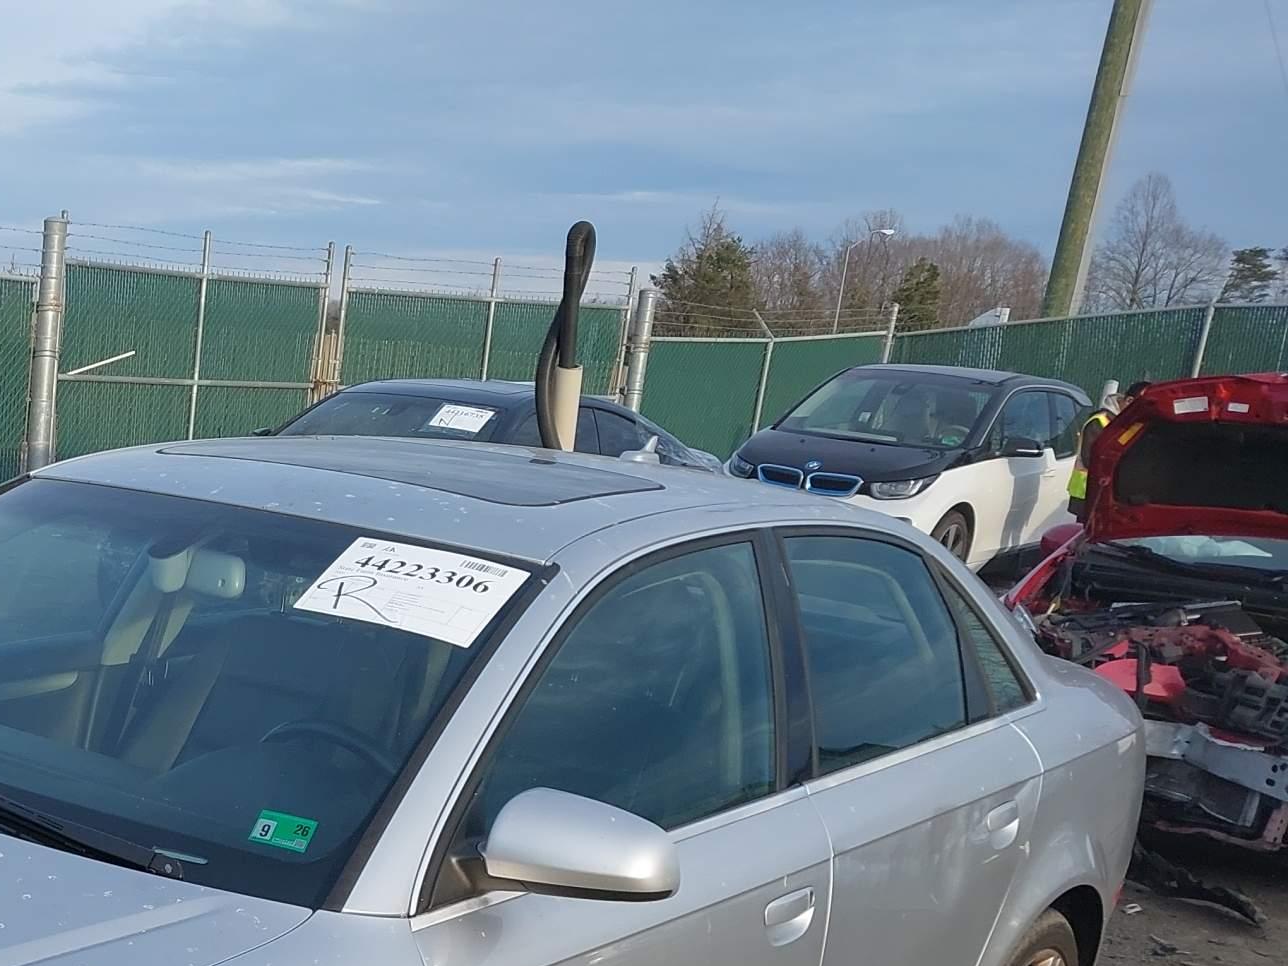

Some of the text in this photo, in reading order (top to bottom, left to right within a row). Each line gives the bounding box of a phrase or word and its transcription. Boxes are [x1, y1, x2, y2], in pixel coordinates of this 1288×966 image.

[354, 555, 496, 594] 44223306
[316, 575, 398, 624] R
[259, 823, 311, 837] 9 26
